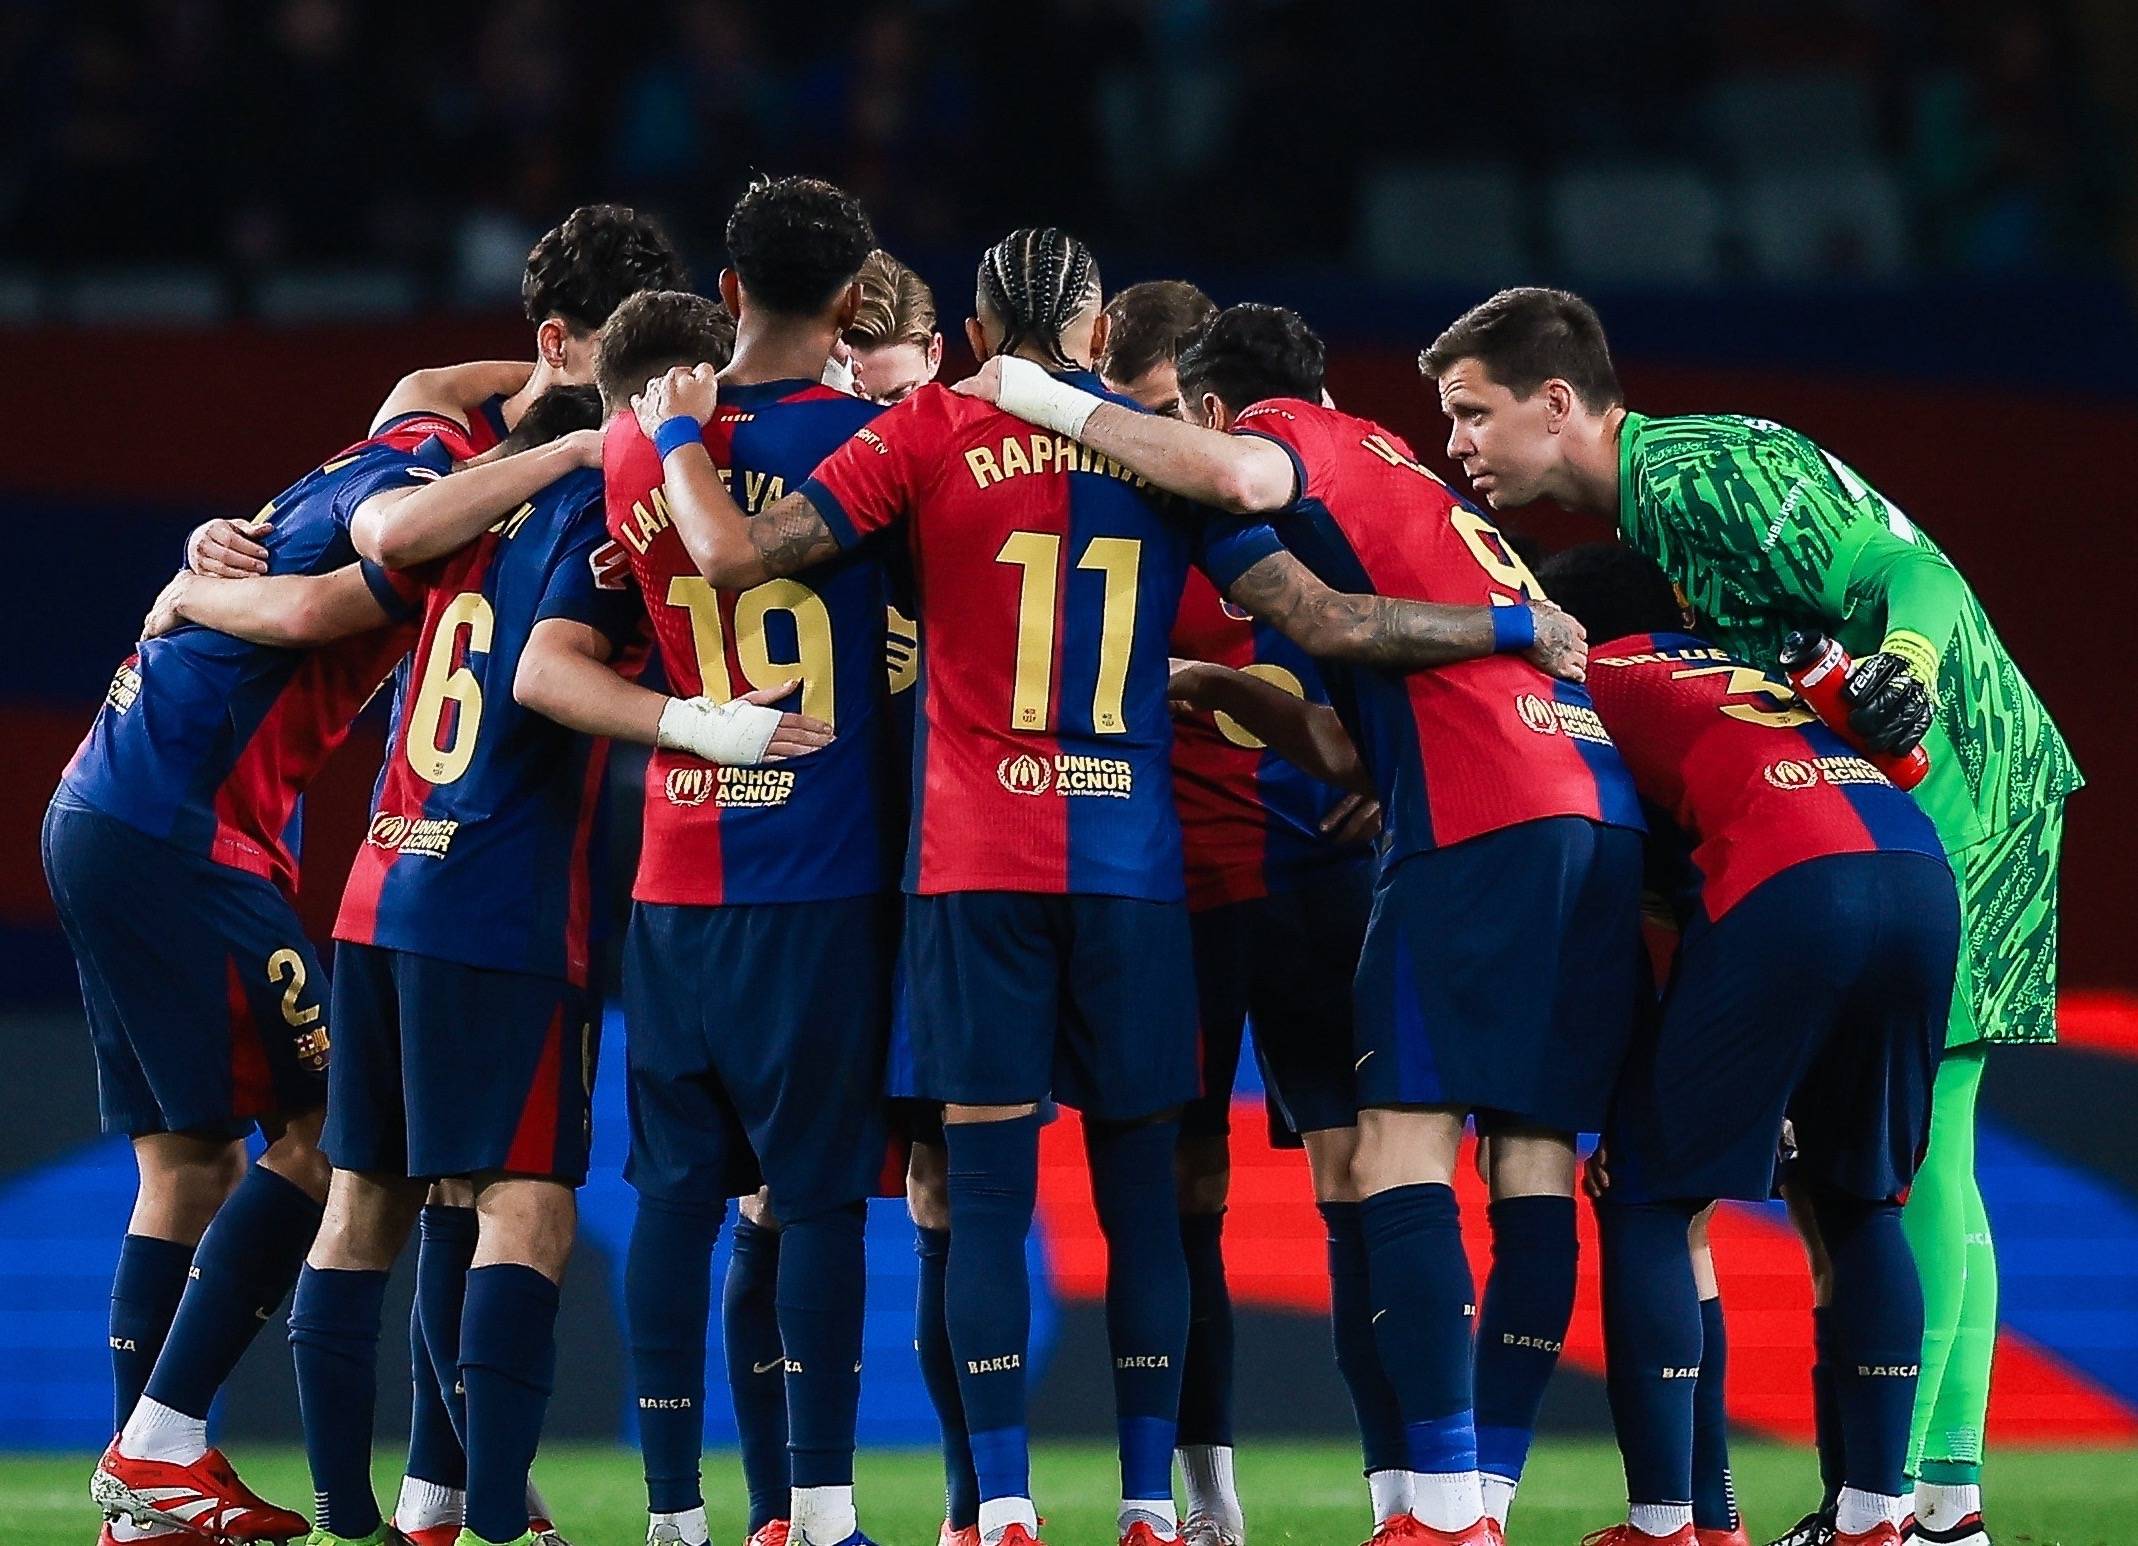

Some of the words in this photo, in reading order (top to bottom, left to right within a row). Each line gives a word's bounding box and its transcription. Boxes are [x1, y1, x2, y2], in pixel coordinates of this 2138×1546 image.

[1450, 505, 1547, 606] 9
[666, 576, 834, 735] 19
[996, 531, 1142, 734] 11
[406, 592, 495, 785] 6
[1672, 665, 1818, 728] 3
[717, 767, 795, 787] UNHCR
[1054, 755, 1132, 775] UNHCR
[1055, 772, 1132, 791] ACNUR
[400, 834, 451, 852] ACNUR
[411, 819, 459, 836] UNHCR
[267, 948, 320, 1027] 2
